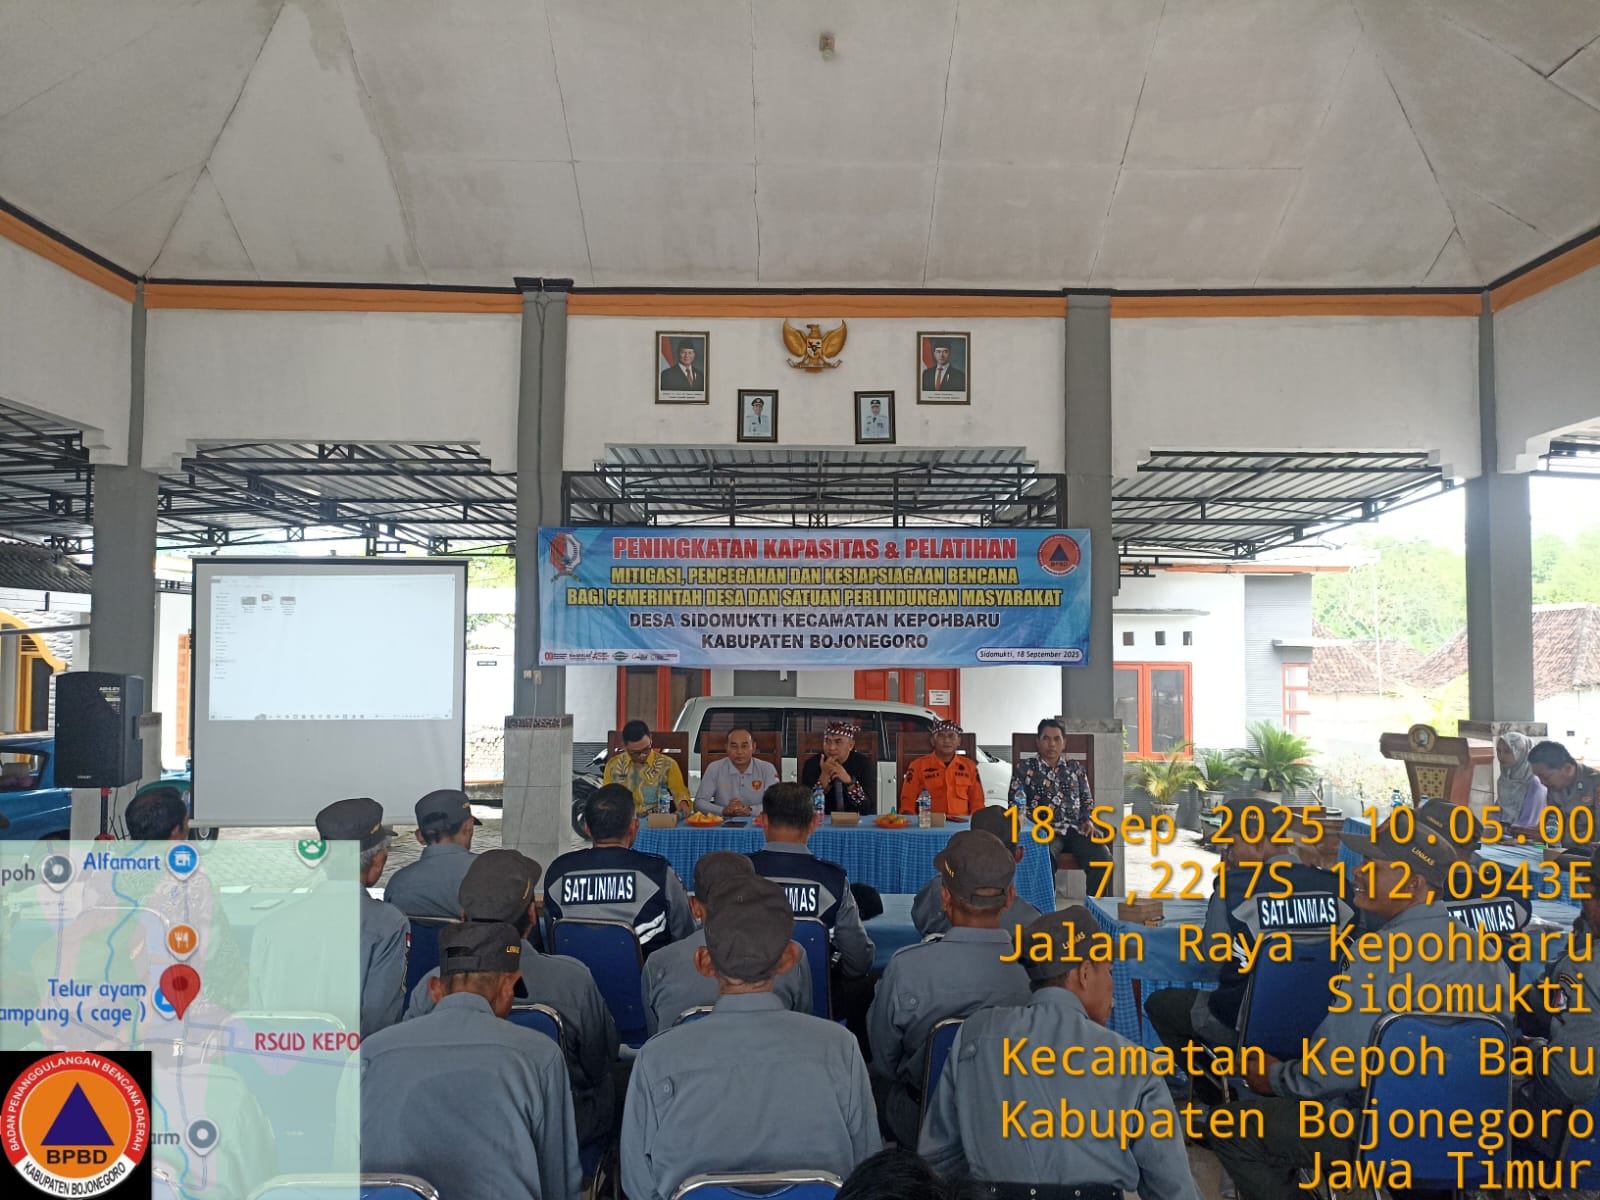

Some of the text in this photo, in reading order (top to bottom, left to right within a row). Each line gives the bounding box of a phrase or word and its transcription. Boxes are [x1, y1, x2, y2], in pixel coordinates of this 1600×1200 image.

[613, 537, 759, 559] PENINGKATAN
[763, 538, 879, 559] KAPASITAS
[884, 541, 900, 559] &
[905, 538, 1017, 559] PELATIHAN
[611, 567, 1019, 585] MITIGASI, PENCEGAHAN DAN KESIAPSIAGAAN BENCANA
[567, 588, 1063, 606] BAGI PEMERINTAH DESA DAN SATUAN PERLINDUNGAN MASYARAKAT
[629, 613, 1000, 628] DESA SIDOMUKTI KECAMATAN KEPOHBARU
[702, 634, 929, 649] KABUPATEN BOJONEGORO
[979, 650, 1080, 660] Sidomukti, 18 September 2025
[563, 874, 634, 902] SATLINMAS
[1261, 897, 1337, 926] SATLINMAS
